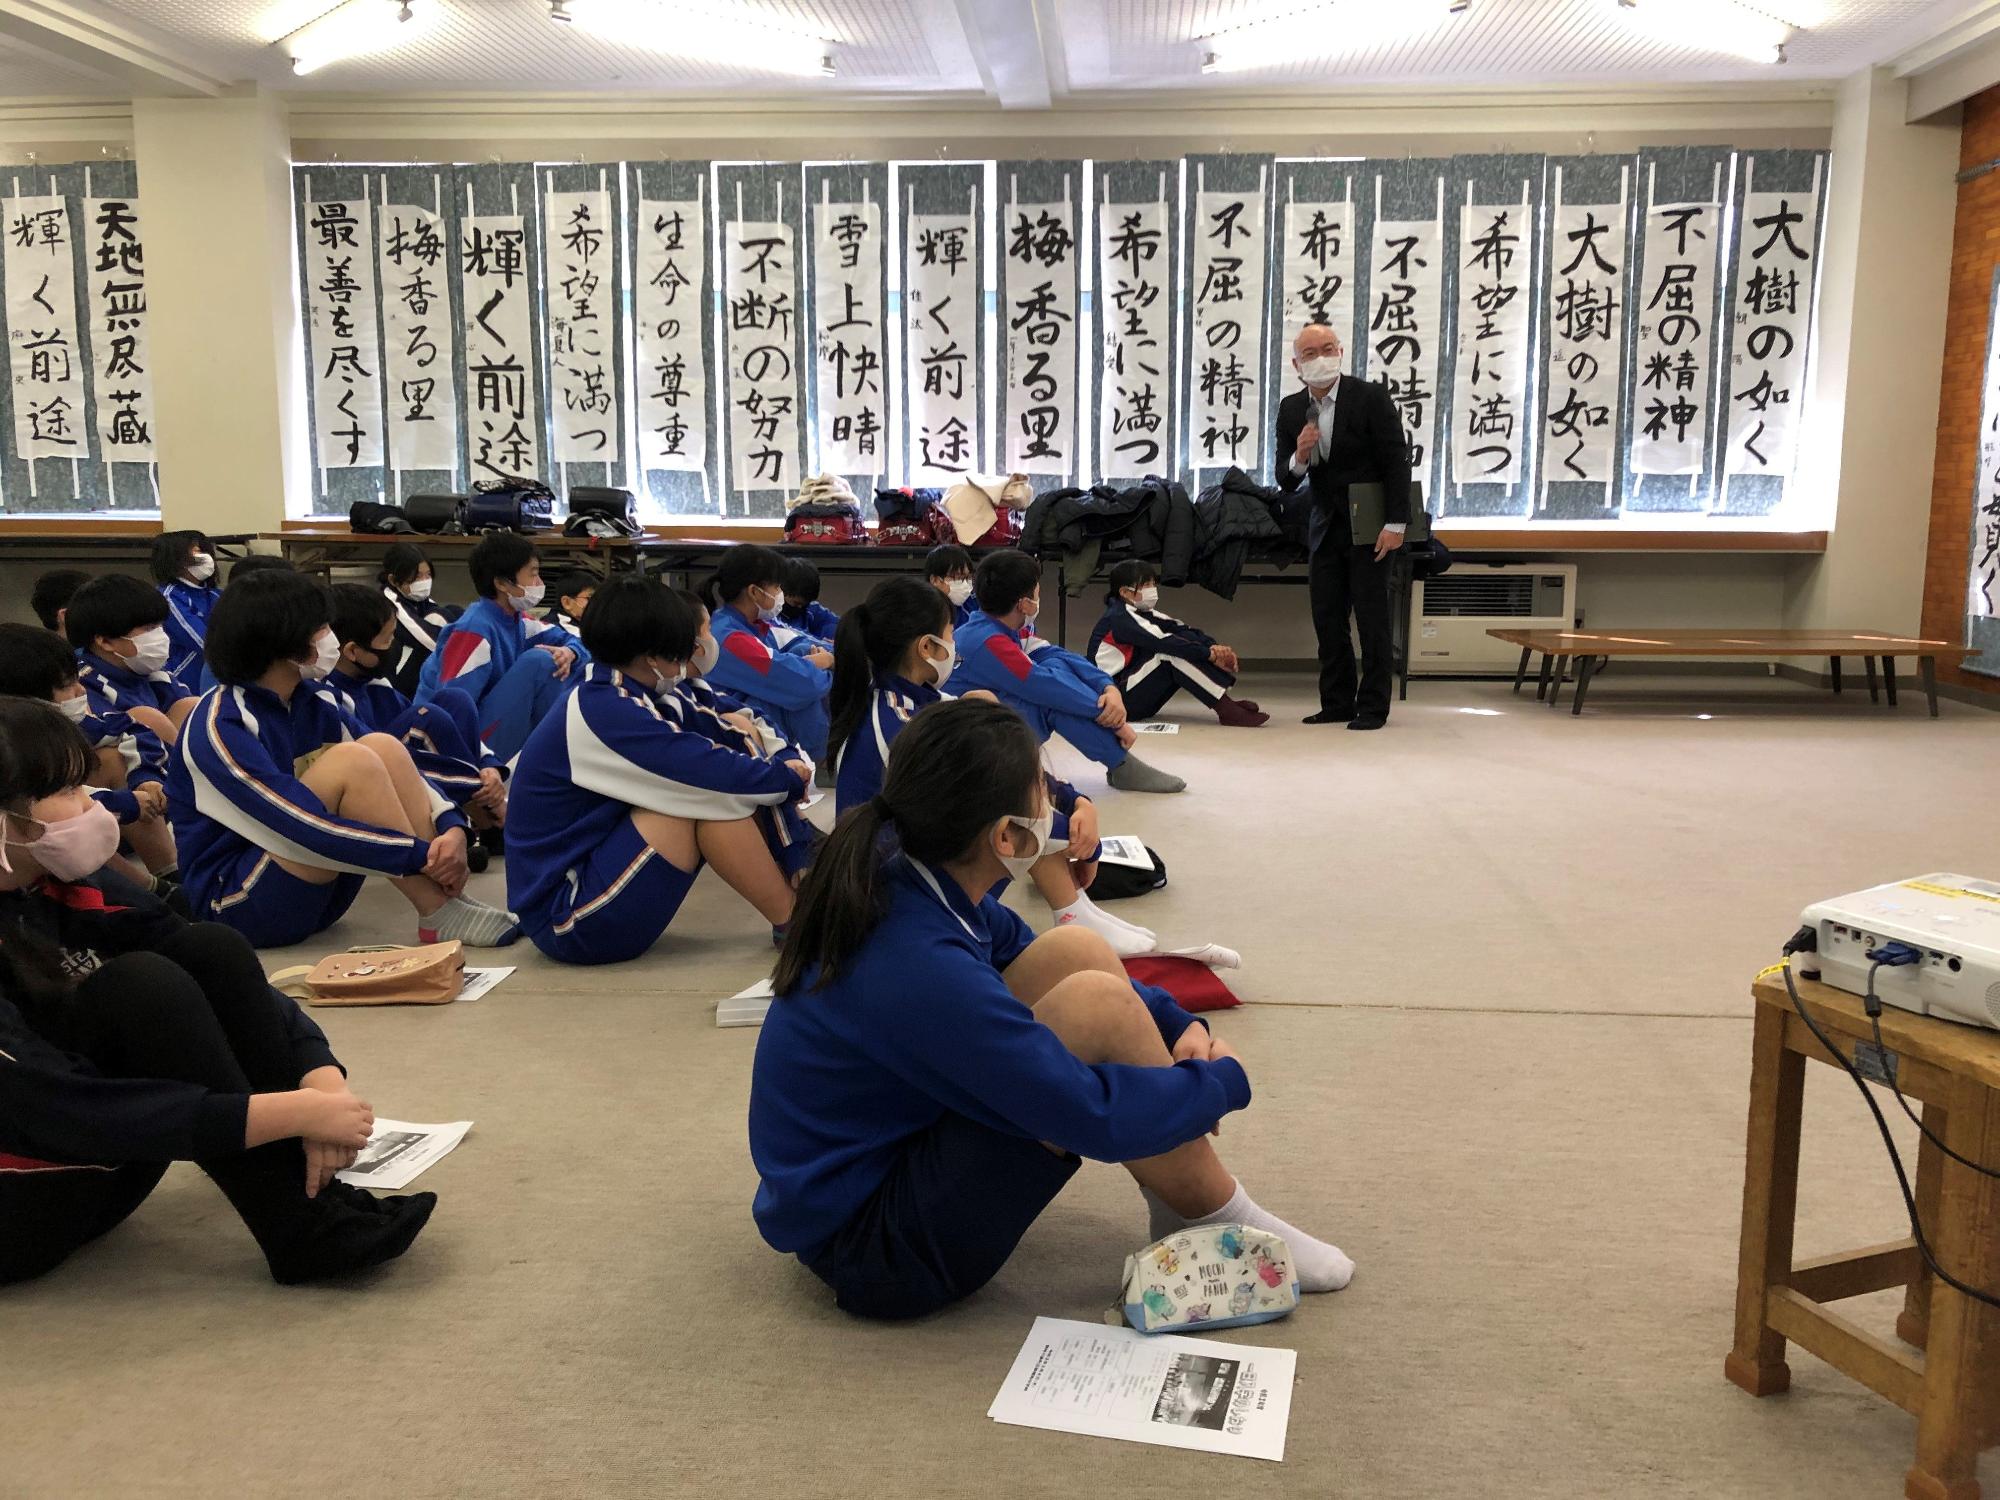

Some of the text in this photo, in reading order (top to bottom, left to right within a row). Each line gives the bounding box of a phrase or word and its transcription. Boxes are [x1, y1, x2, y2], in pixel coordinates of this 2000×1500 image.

[10, 208, 78, 445] 輝く前途
[95, 202, 152, 445] 天地無尽蔵
[310, 202, 373, 465] 最善を尽くす
[385, 216, 445, 422] 梅香る里
[463, 227, 533, 482] 輝く前途
[560, 203, 612, 451] 希望に満つ
[650, 211, 691, 456] 生命の尊重
[732, 238, 794, 483] 不断の努力
[827, 215, 882, 456] 雪上快晴
[915, 226, 970, 472] 輝く前途
[1009, 209, 1074, 460] 梅香る里
[1109, 211, 1162, 464] 希望に満つ
[1197, 202, 1255, 461] 不屈の精神
[1464, 210, 1520, 475] 希望に満つ
[1547, 212, 1621, 480] 大樹の如く
[1641, 207, 1707, 443] 不屈の精神
[1733, 199, 1809, 466] 大樹の如く
